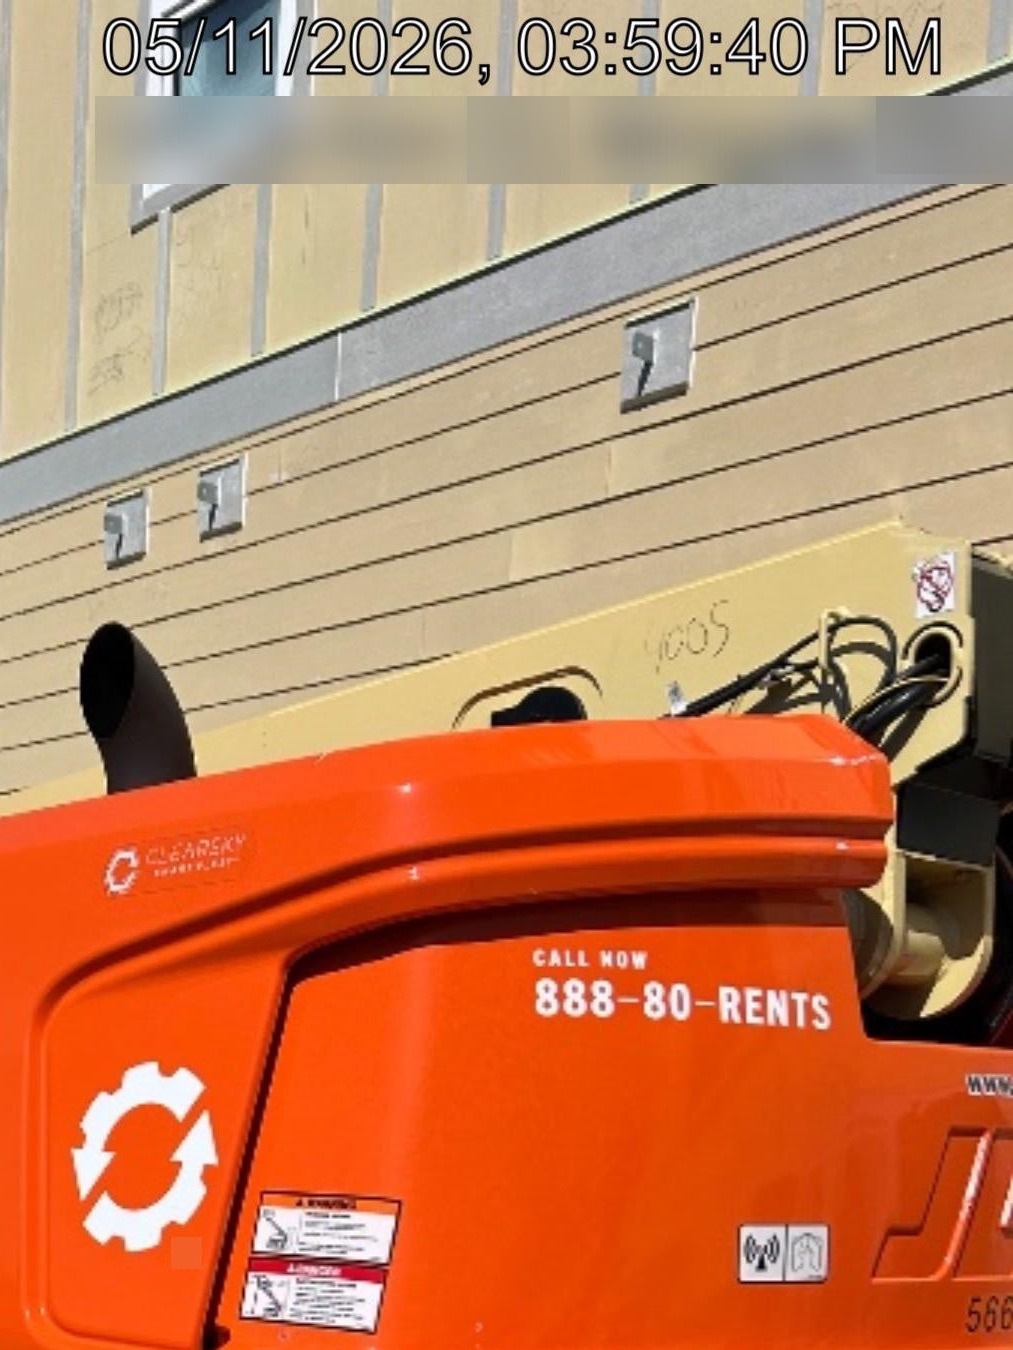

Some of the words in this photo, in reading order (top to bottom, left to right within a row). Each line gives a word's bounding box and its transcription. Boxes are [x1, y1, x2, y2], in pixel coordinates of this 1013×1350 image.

[532, 948, 590, 968] CALL
[600, 950, 648, 970] NOW
[535, 977, 832, 1031] 888-80-RENTS
